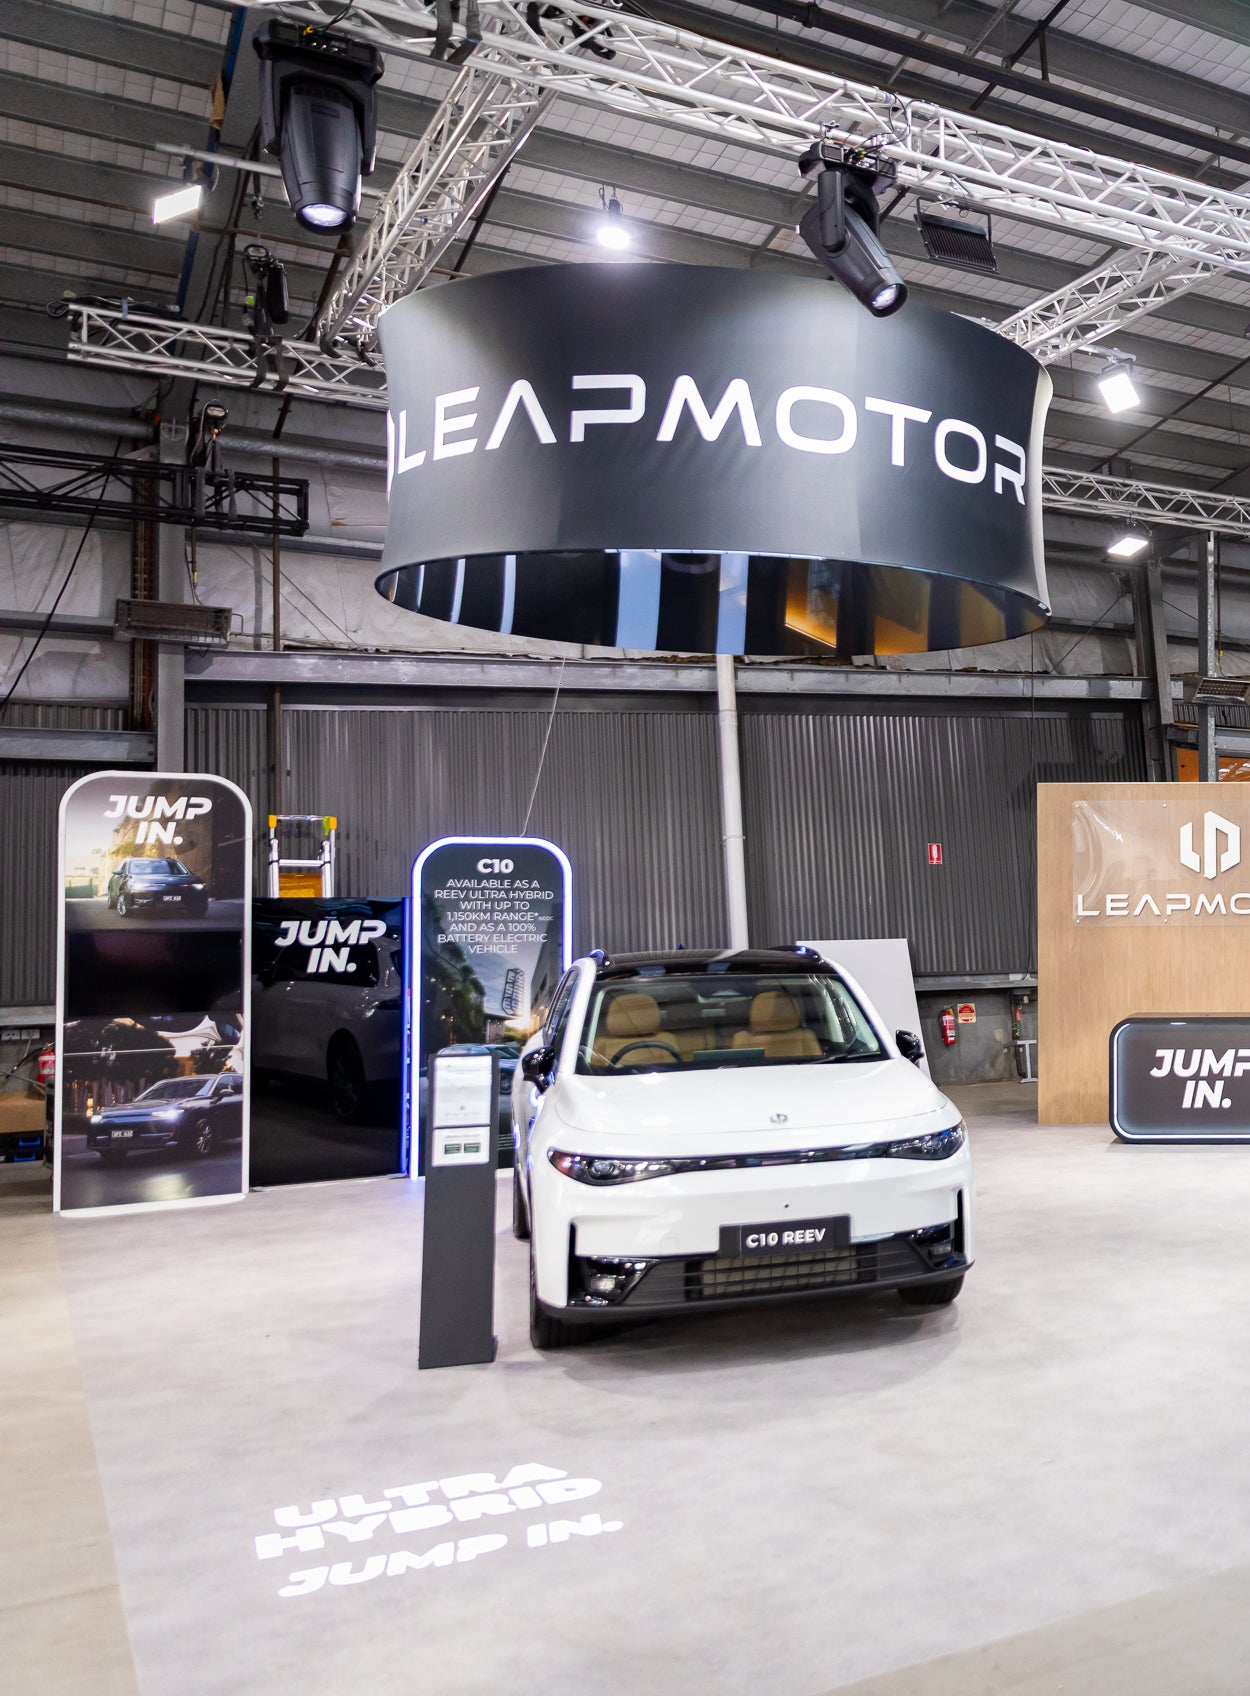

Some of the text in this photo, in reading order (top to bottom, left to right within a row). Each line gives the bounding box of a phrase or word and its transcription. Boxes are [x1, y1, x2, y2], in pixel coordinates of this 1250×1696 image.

[397, 374, 1026, 505] LEAPMOTOR
[103, 795, 213, 820] JUMP
[134, 821, 184, 846] IN.
[476, 858, 514, 874] C10
[434, 890, 554, 900] REEV ULTRA HYBRID
[446, 879, 540, 889] AVAILABLE AS A
[460, 901, 530, 910] WITH UP TO
[446, 912, 491, 922] 1,150KM
[450, 923, 536, 932] AND AS A 100%
[274, 920, 387, 946] JUMP
[438, 933, 548, 943] BATTERY ELECTRIC
[306, 947, 357, 973] IN.
[468, 945, 518, 954] VEHICLE
[1181, 1080, 1232, 1109] IN.
[745, 1228, 826, 1248] C10 REEV
[274, 1463, 568, 1527] ULTRA
[255, 1478, 602, 1560] HYBRID
[277, 1513, 624, 1598] JUMP IN.
